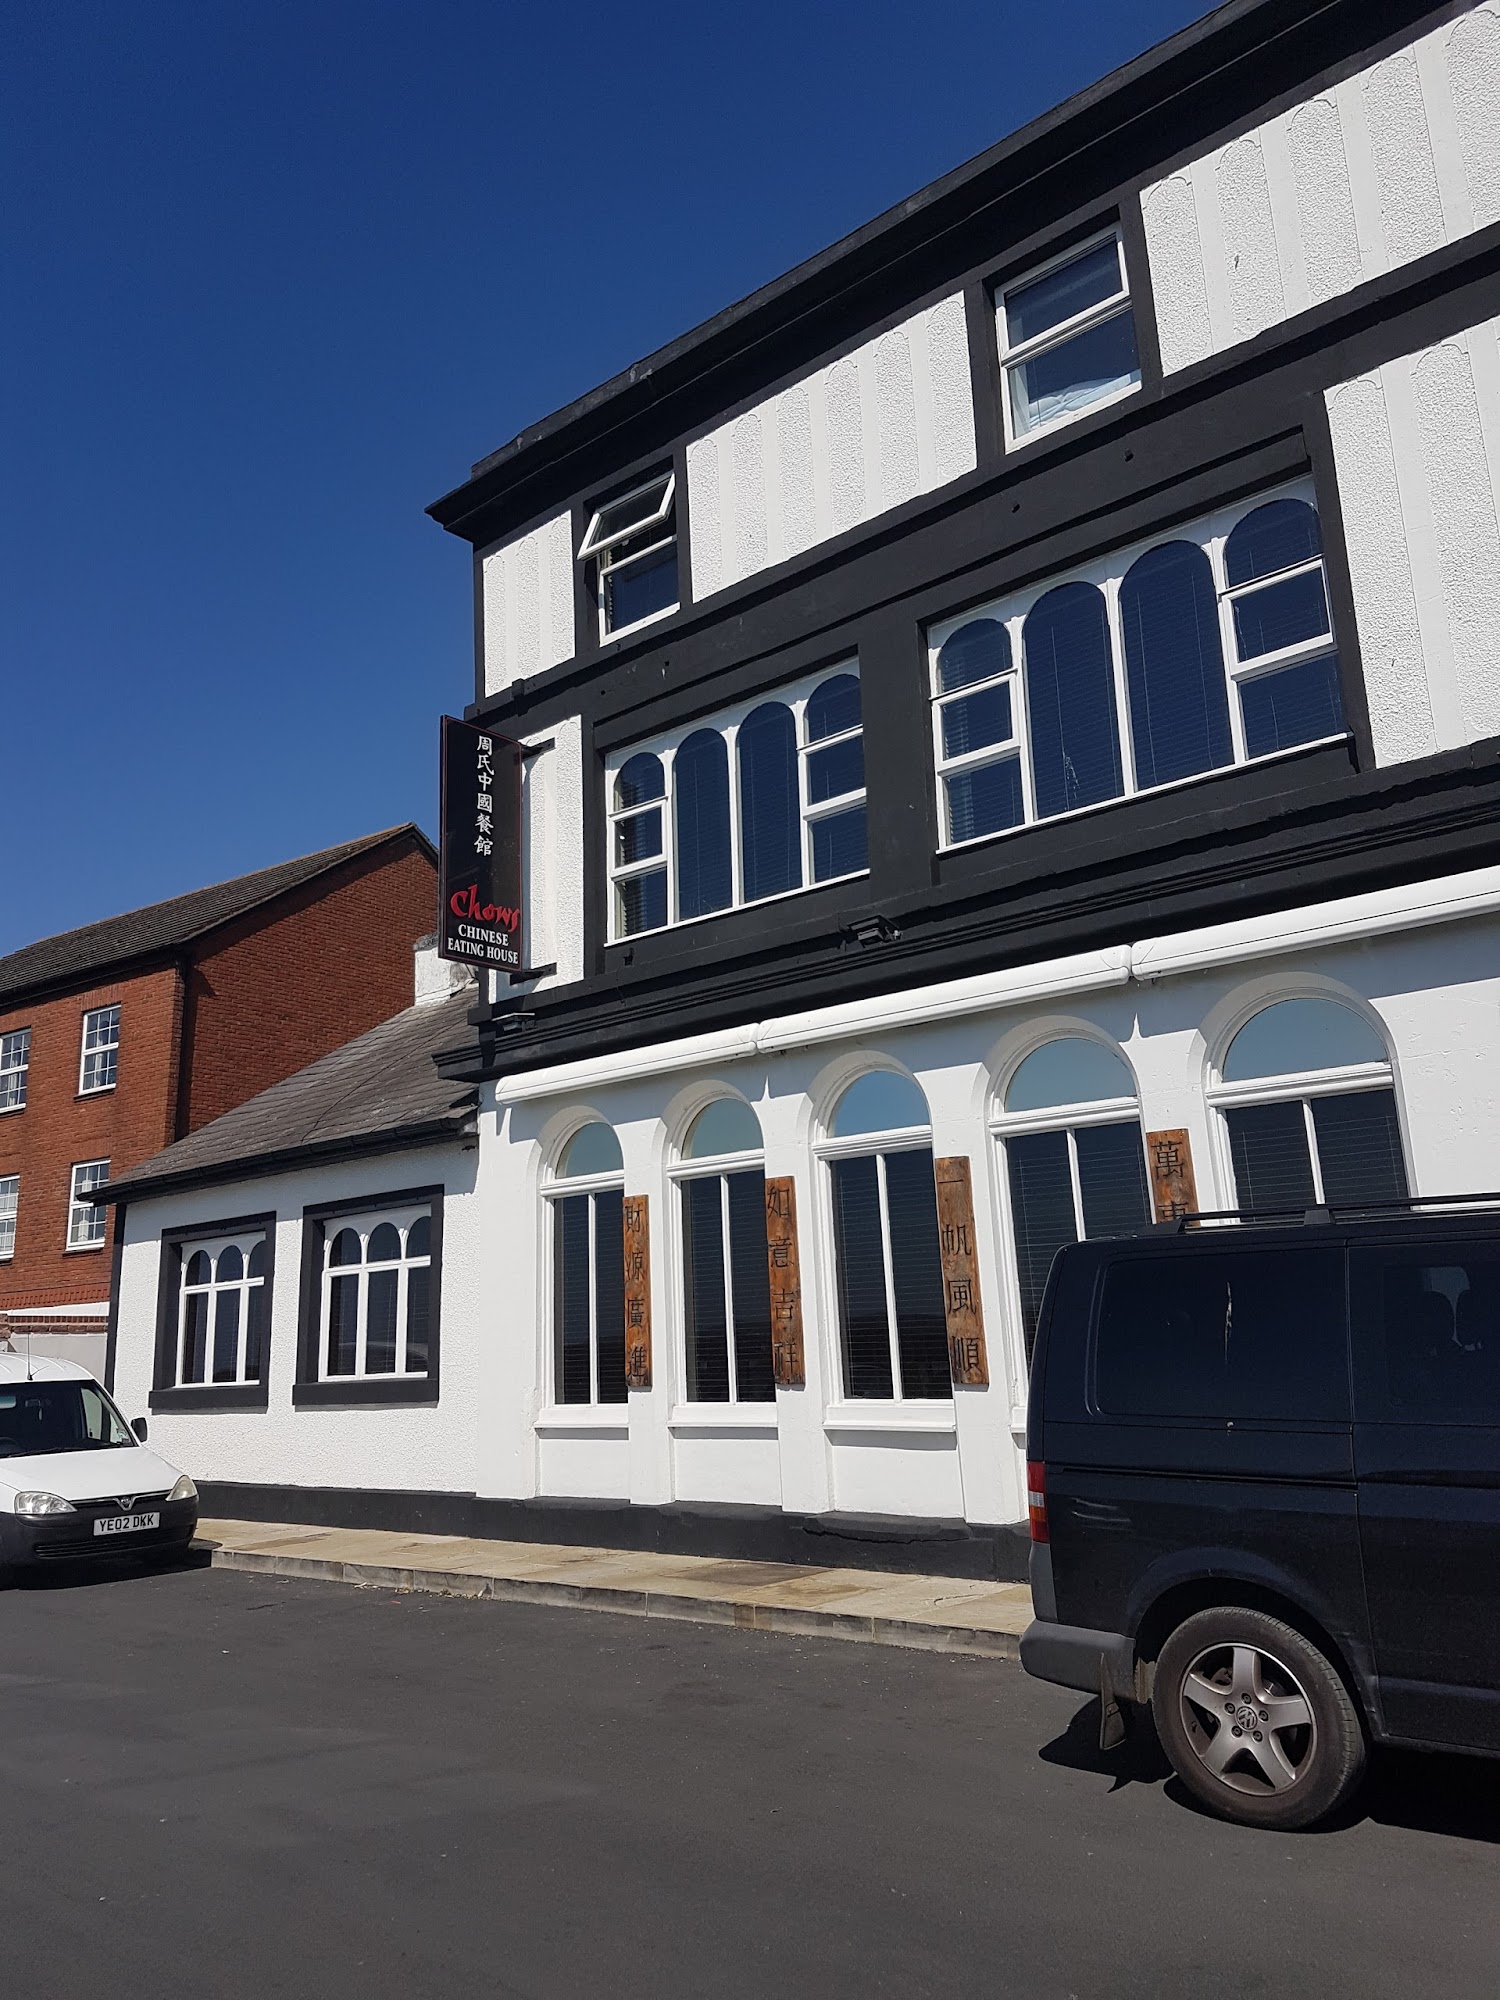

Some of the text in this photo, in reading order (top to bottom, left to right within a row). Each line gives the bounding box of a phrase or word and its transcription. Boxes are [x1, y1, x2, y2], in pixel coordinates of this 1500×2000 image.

[474, 735, 495, 857] 周氏中國餐館
[447, 937, 519, 965] EATING HOUSE
[450, 883, 520, 933] Chows
[458, 923, 509, 947] CHINESE
[624, 1204, 647, 1378] 財源廣進
[766, 1185, 799, 1375] 如意吉祥
[937, 1178, 983, 1375] 一帆風順
[99, 1513, 155, 1532] YE02 DKK
